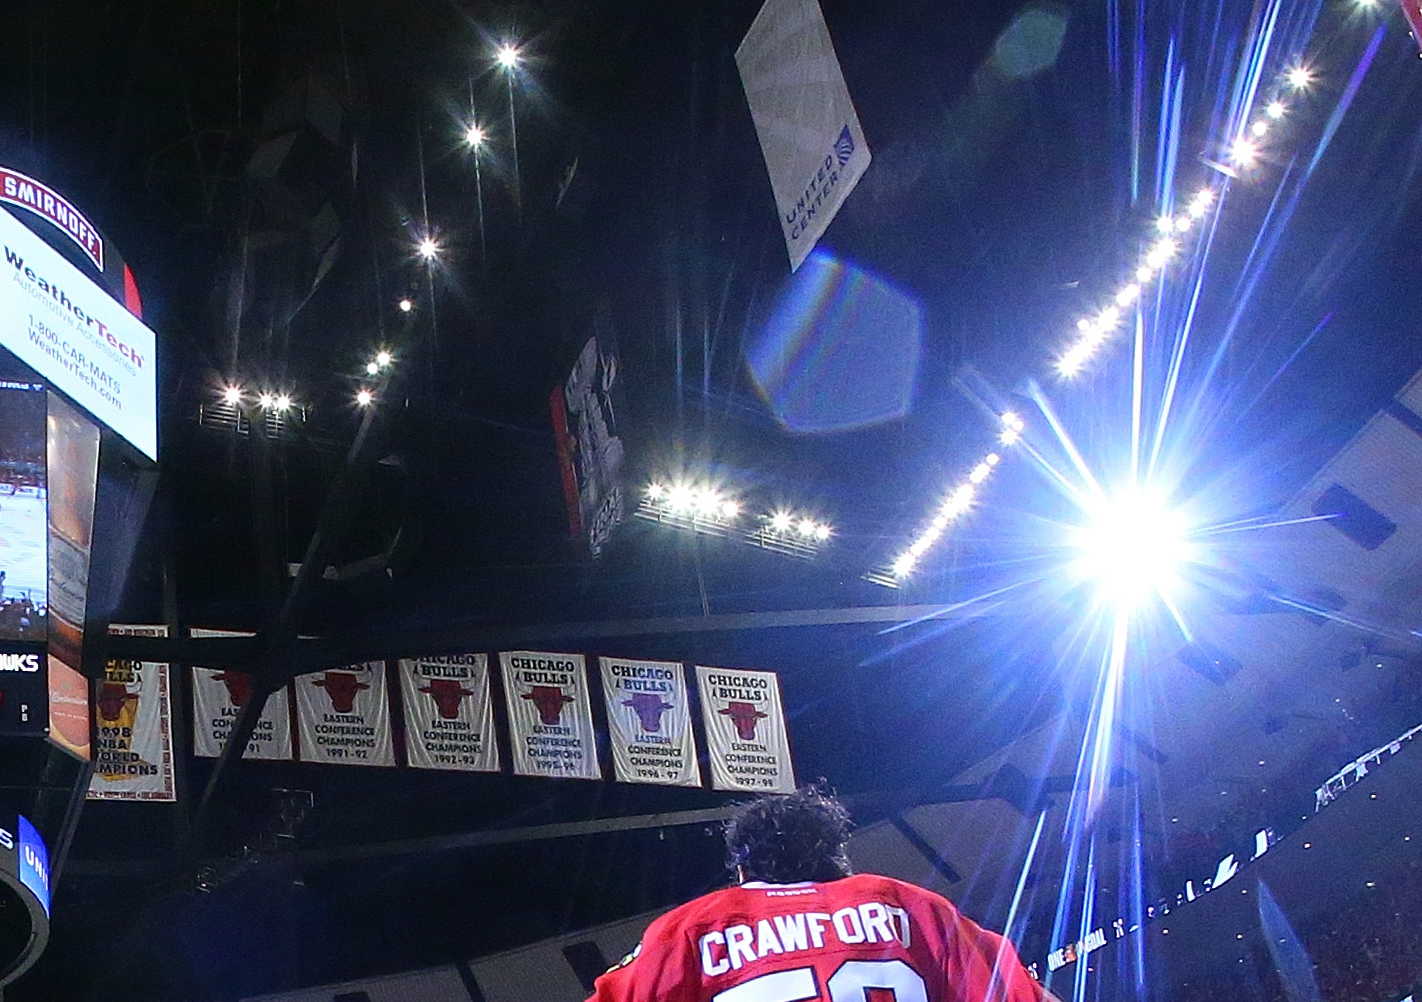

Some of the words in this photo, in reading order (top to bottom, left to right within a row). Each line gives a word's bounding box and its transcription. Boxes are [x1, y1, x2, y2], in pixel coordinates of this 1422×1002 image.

[786, 154, 833, 224] UNITED
[791, 172, 838, 241] CENTER
[4, 176, 96, 254] SMIRNOFF
[3, 245, 144, 369] WeatherTech
[28, 315, 121, 395] 1-800-CAR-MATS
[27, 327, 122, 410] WeatherTech.com
[422, 665, 468, 678] BULLS
[511, 658, 574, 672] CHICAGO
[523, 671, 569, 685] BULLS
[611, 665, 673, 682] CHICAGO
[624, 679, 667, 692] BULLS
[708, 674, 767, 689] CHICAGO
[719, 687, 762, 700] BULLS
[324, 713, 364, 723] EASTERN
[315, 725, 375, 736] CONFERENCE
[98, 739, 128, 750] NBA
[317, 736, 376, 747] CHAMPIONS
[699, 902, 911, 977] CRAWFORD
